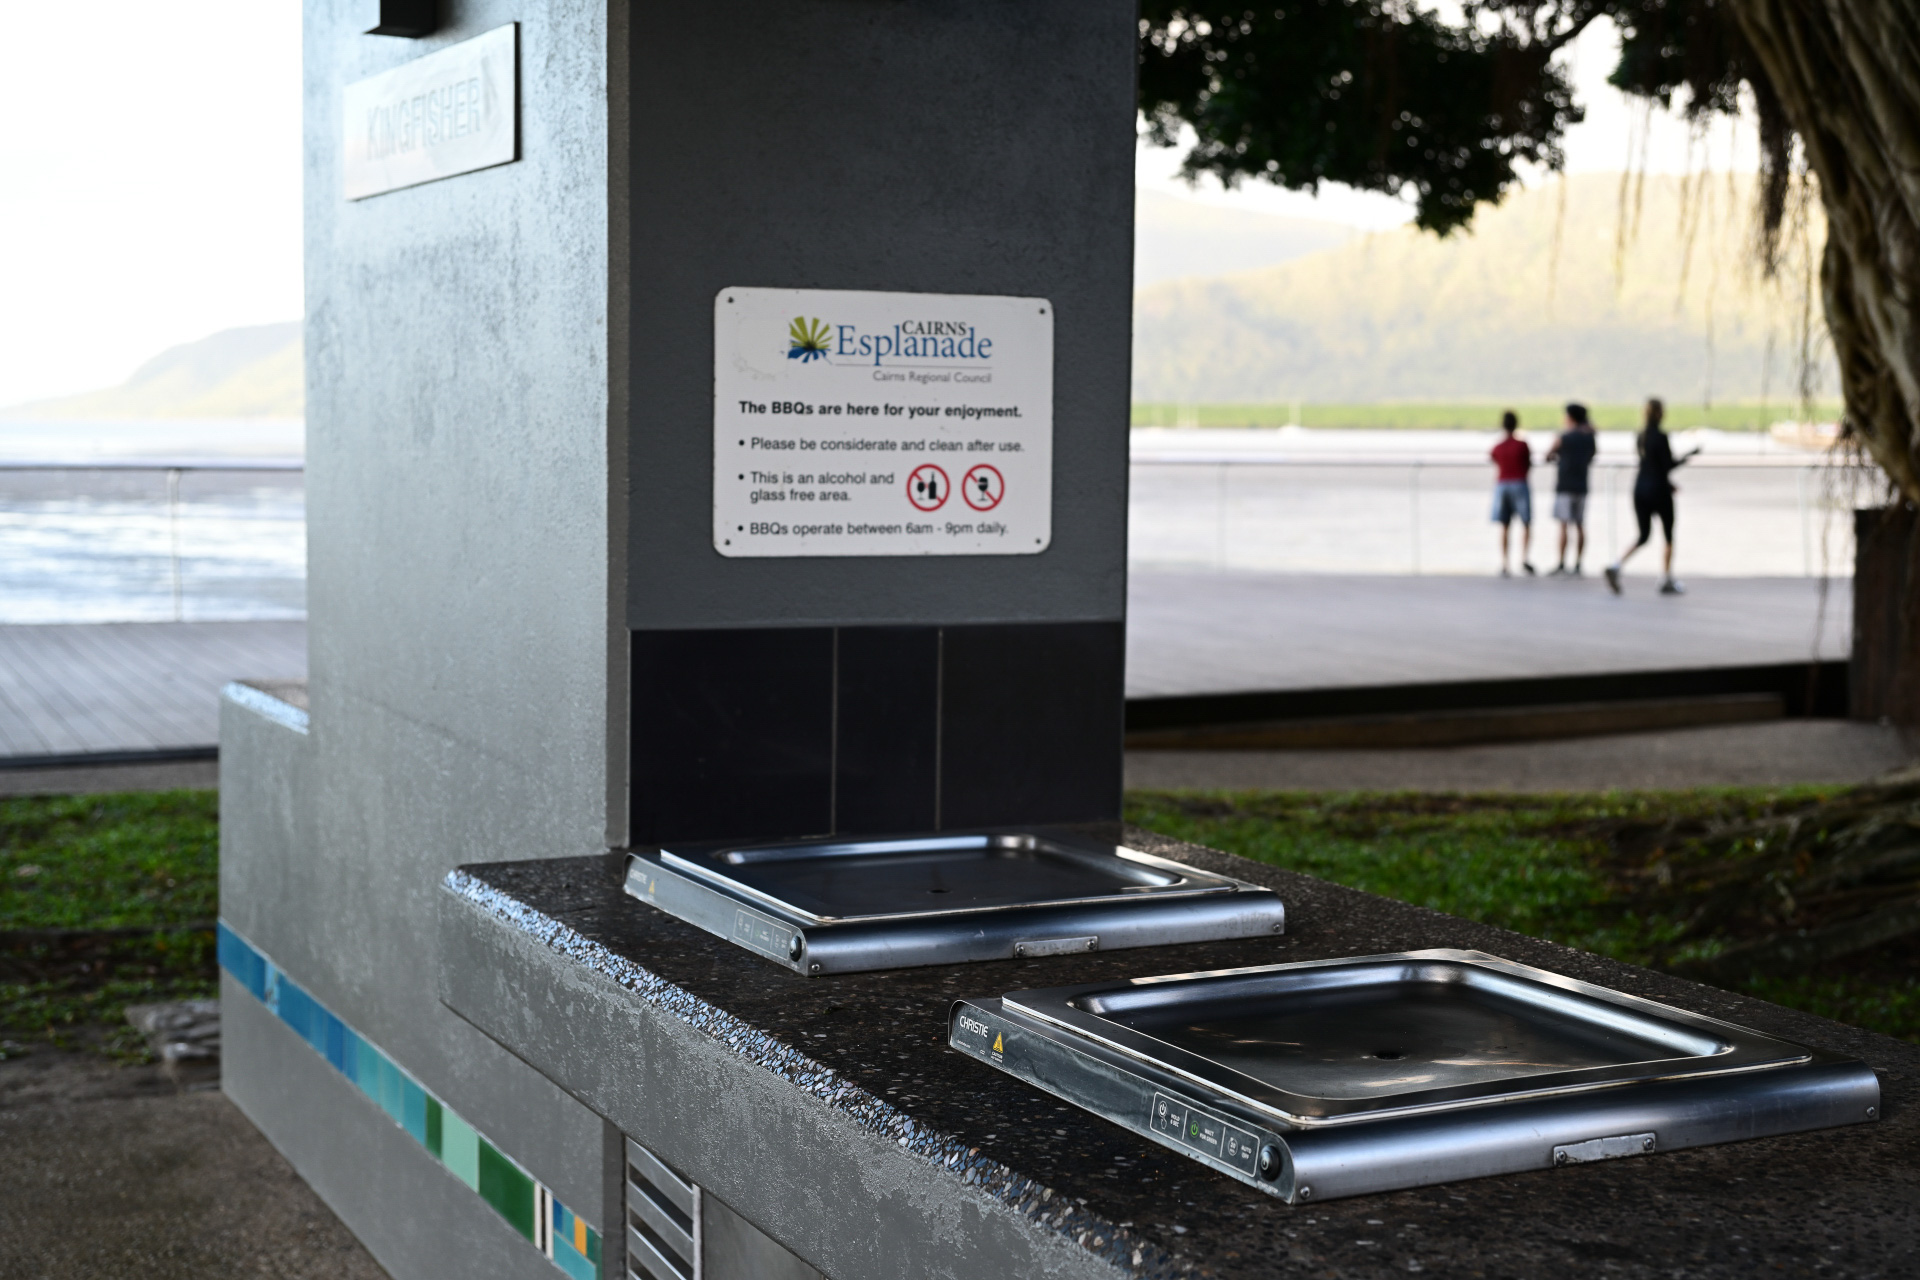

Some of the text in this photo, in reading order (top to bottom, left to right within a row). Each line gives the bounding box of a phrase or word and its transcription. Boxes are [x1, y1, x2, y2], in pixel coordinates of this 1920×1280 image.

[367, 77, 481, 161] KINGFISHER
[902, 321, 966, 335] CAIRNS
[836, 323, 992, 366] Esplanade
[874, 371, 991, 384] Cairns Regional Council
[739, 401, 1022, 420] The BBQs are here for your enjoyment.
[751, 437, 1024, 451] Please be considerate and clean after use.
[751, 471, 894, 484] This is an alcohol and
[750, 488, 851, 503] glass free area.
[750, 522, 788, 535] BBQs
[793, 524, 843, 537] operate
[847, 523, 902, 534] between
[906, 523, 933, 534] 6am
[945, 522, 973, 535] 9pm
[977, 523, 1008, 536] daily.
[960, 1016, 988, 1038] CHRISTIE
